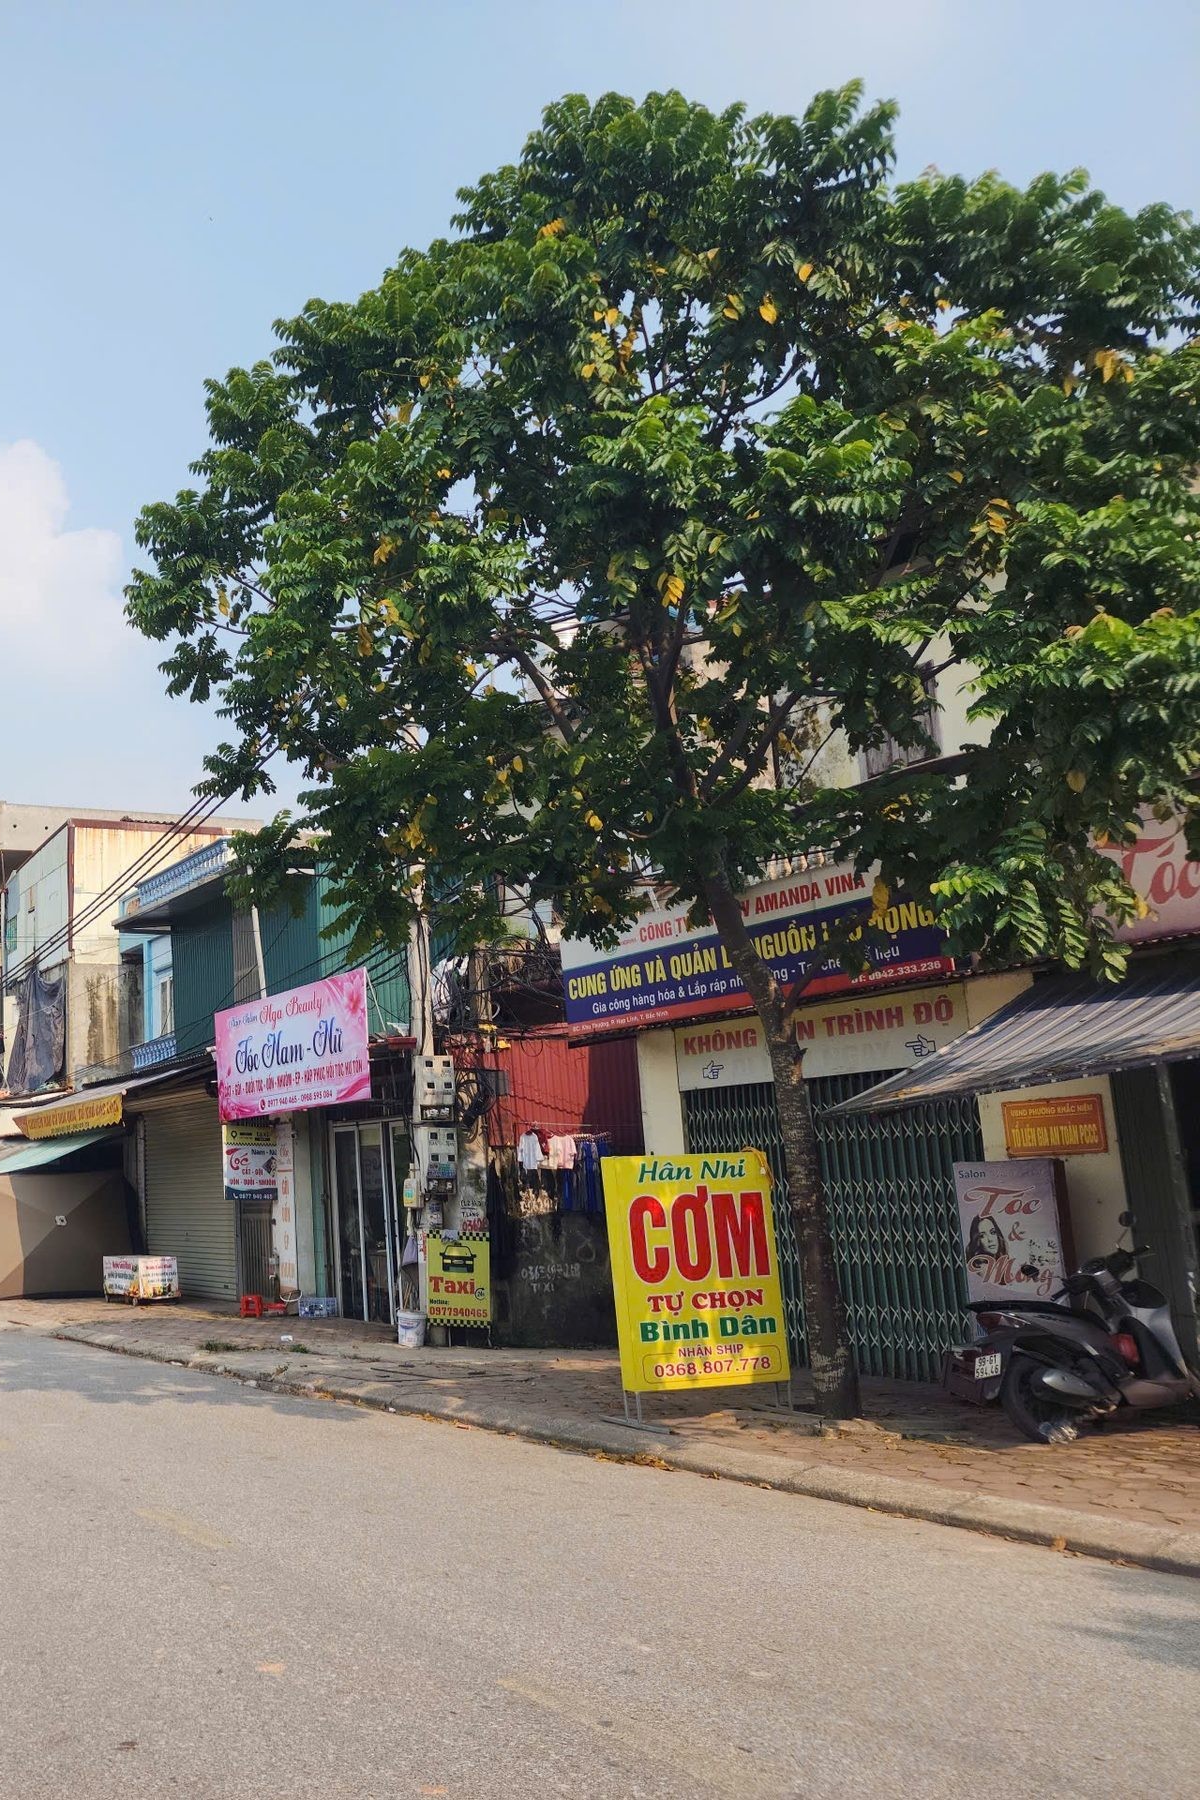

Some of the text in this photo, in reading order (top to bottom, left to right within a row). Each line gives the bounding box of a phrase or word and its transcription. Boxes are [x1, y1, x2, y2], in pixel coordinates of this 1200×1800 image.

[640, 921, 673, 942] CÔNG
[755, 882, 822, 914] AMANDA
[568, 972, 607, 1000] CUNG
[610, 965, 642, 990] ỨNG
[644, 954, 667, 984] VÀ
[670, 943, 717, 981] QUẢN
[592, 1002, 607, 1014] Gia
[608, 998, 631, 1012] công
[632, 993, 656, 1007] hàng
[657, 987, 675, 1000] hóa
[678, 986, 686, 998] &
[688, 981, 707, 998] Lắp
[710, 976, 727, 993] ráp
[260, 1004, 282, 1030] Nga
[286, 991, 323, 1018] Beauty
[684, 1028, 758, 1055] KHÔNG
[822, 1004, 905, 1038] TRÌNH
[913, 994, 954, 1026] ĐỘ
[235, 1035, 260, 1074] Tóc
[261, 1030, 304, 1069] Nam
[1037, 1125, 1050, 1147] GIA
[1050, 1125, 1061, 1146] AN
[1061, 1121, 1078, 1146] TOÀN
[1079, 1123, 1099, 1145] PCCC
[226, 1147, 249, 1170] Tóc
[638, 1160, 692, 1183] Hân
[958, 1169, 987, 1179] Salon
[964, 1186, 1042, 1218] Tóc
[629, 1186, 771, 1284] CƠM
[1008, 1221, 1026, 1242] &
[429, 1276, 476, 1295] Taxi
[429, 1306, 488, 1318] 0977940465
[647, 1289, 764, 1316] TỰ CHỌN
[640, 1315, 777, 1342] Bình Dân
[678, 1343, 745, 1359] NHẬN SHIP
[654, 1357, 771, 1378] 0368.807.778
